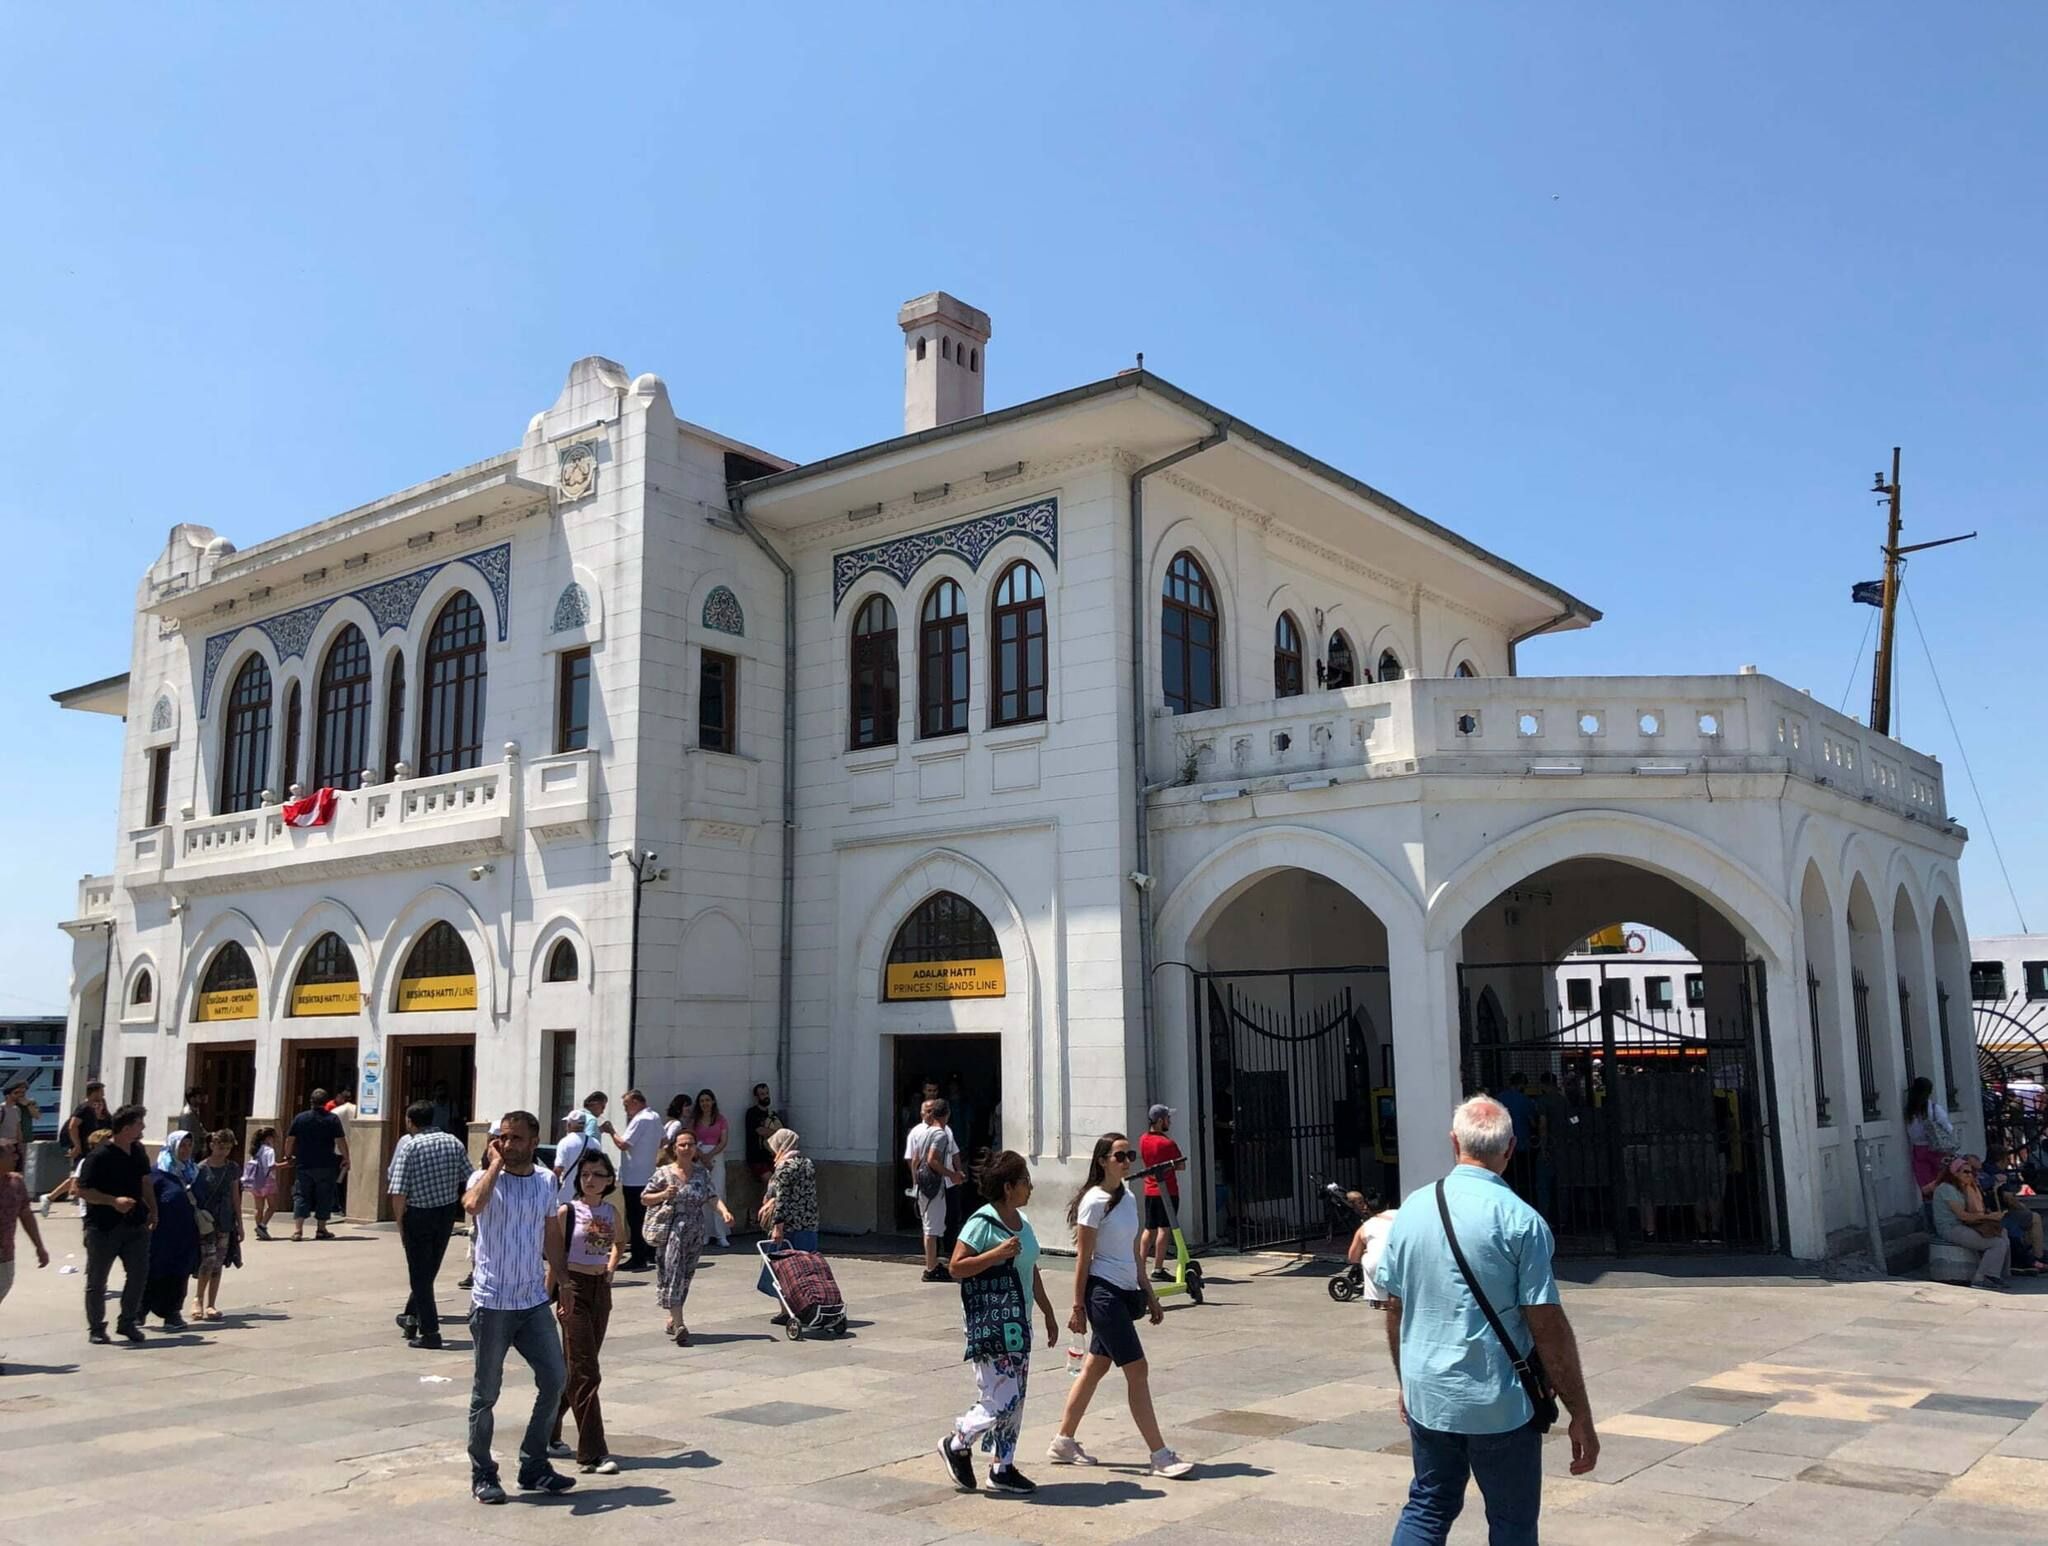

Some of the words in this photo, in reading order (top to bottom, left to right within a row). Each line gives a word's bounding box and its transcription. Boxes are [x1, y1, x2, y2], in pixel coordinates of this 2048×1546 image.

[913, 968, 948, 979] ADALAR
[950, 967, 976, 977] HATTI
[436, 988, 454, 997] HATTI
[459, 987, 474, 997] LINE
[935, 981, 974, 992] ISLANDS
[976, 980, 998, 990] LINE
[1003, 1321, 1025, 1352] B
